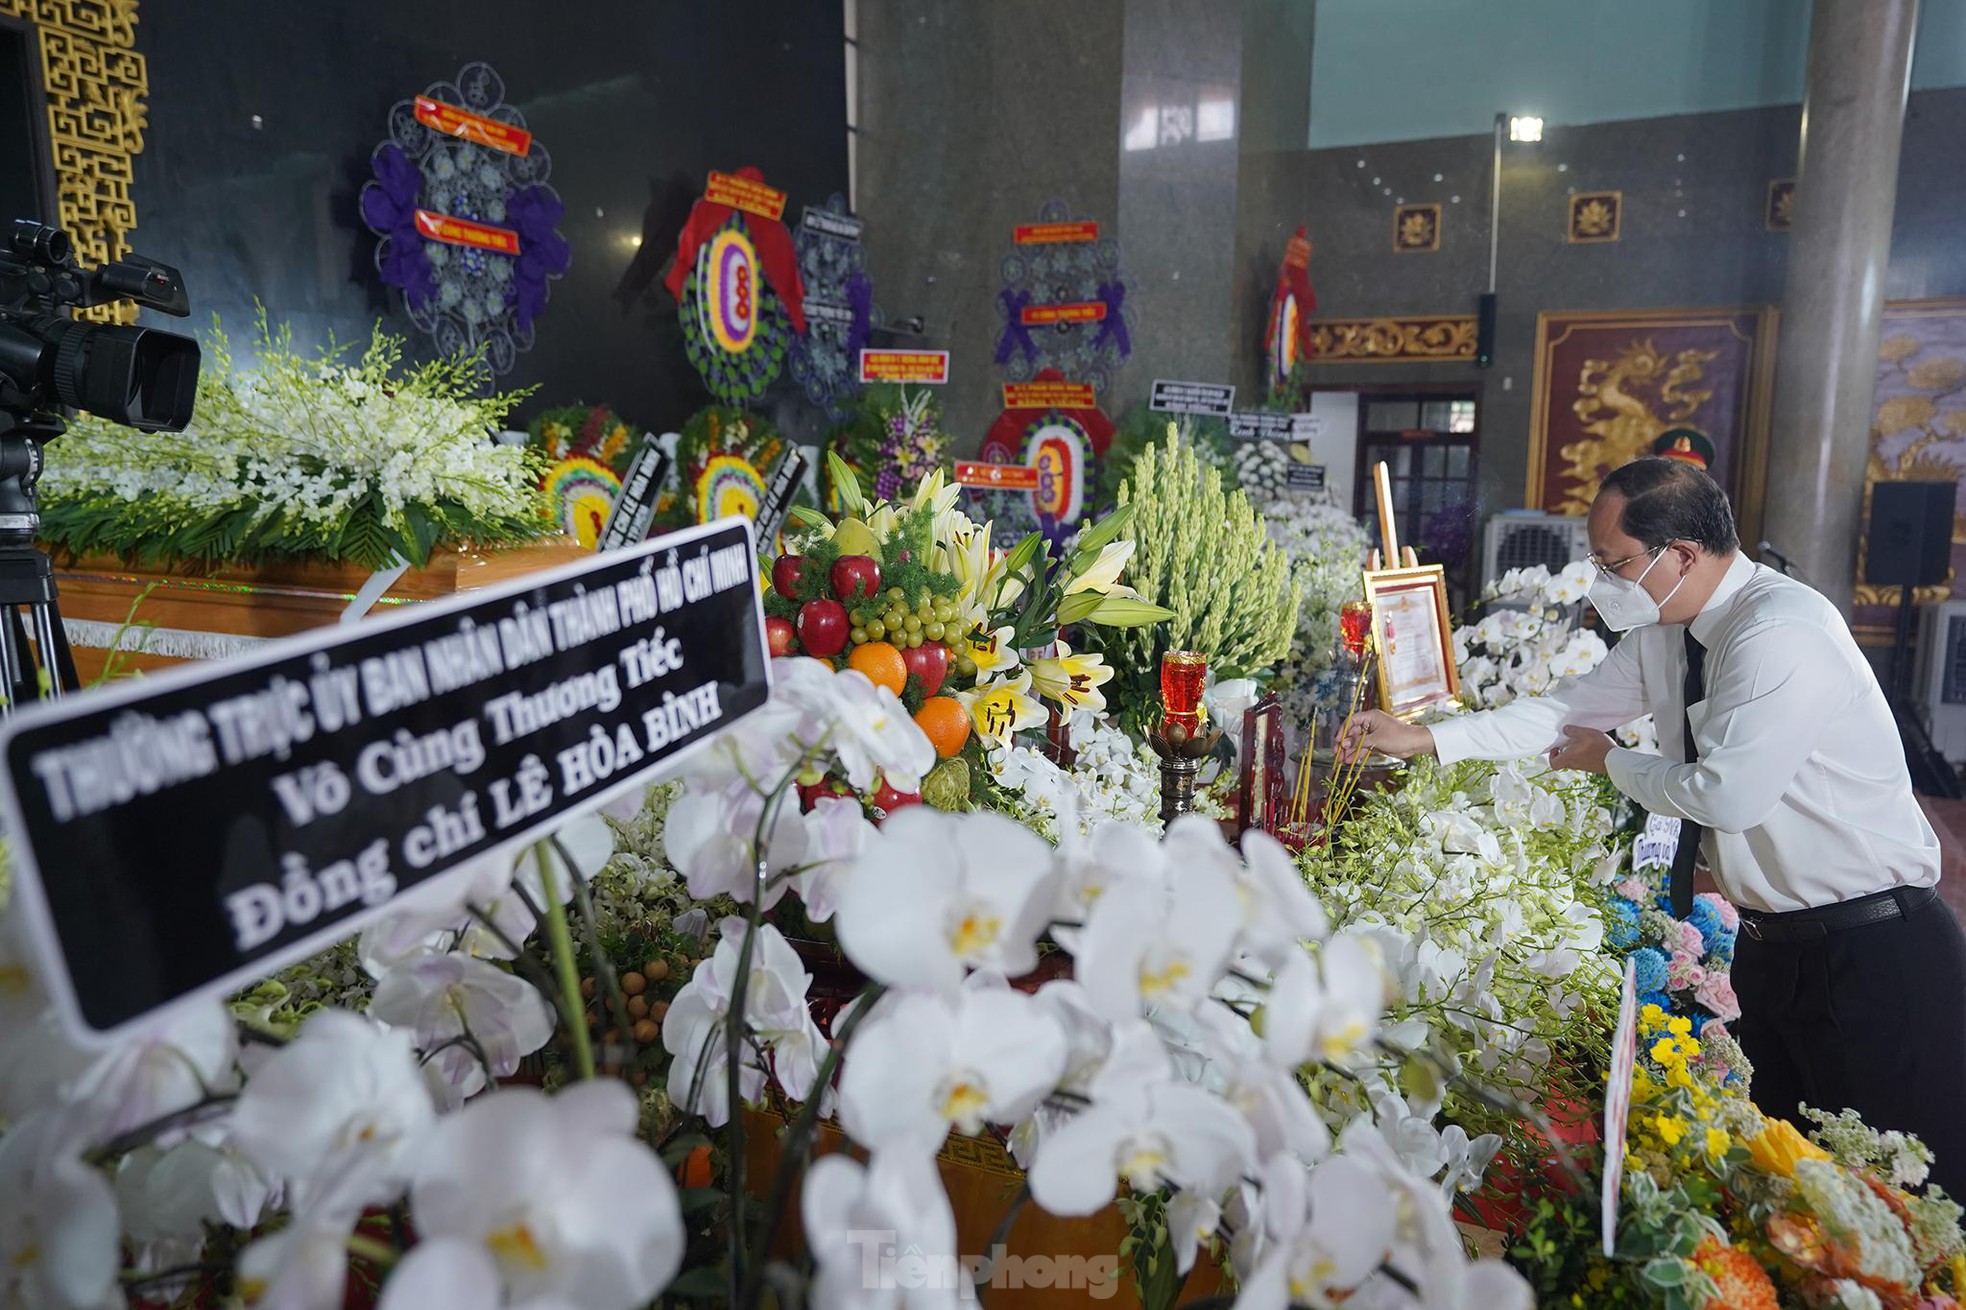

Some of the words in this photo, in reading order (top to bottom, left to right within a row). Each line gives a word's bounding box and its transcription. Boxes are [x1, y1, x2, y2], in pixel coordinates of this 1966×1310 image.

[271, 760, 352, 828] Vô
[356, 717, 487, 796] Cùng
[618, 625, 685, 690] Tiếc
[359, 645, 432, 718] BAN
[424, 614, 504, 695] NHÂN
[498, 599, 554, 671] DÂN
[614, 555, 659, 628] PHỐ
[681, 544, 714, 604] CHÍ
[708, 542, 750, 594] MINH
[224, 838, 399, 954] Đồng
[403, 791, 487, 870] chí
[489, 752, 555, 830] LÊ
[556, 722, 645, 798] HÒA
[641, 681, 725, 753] BÌNH
